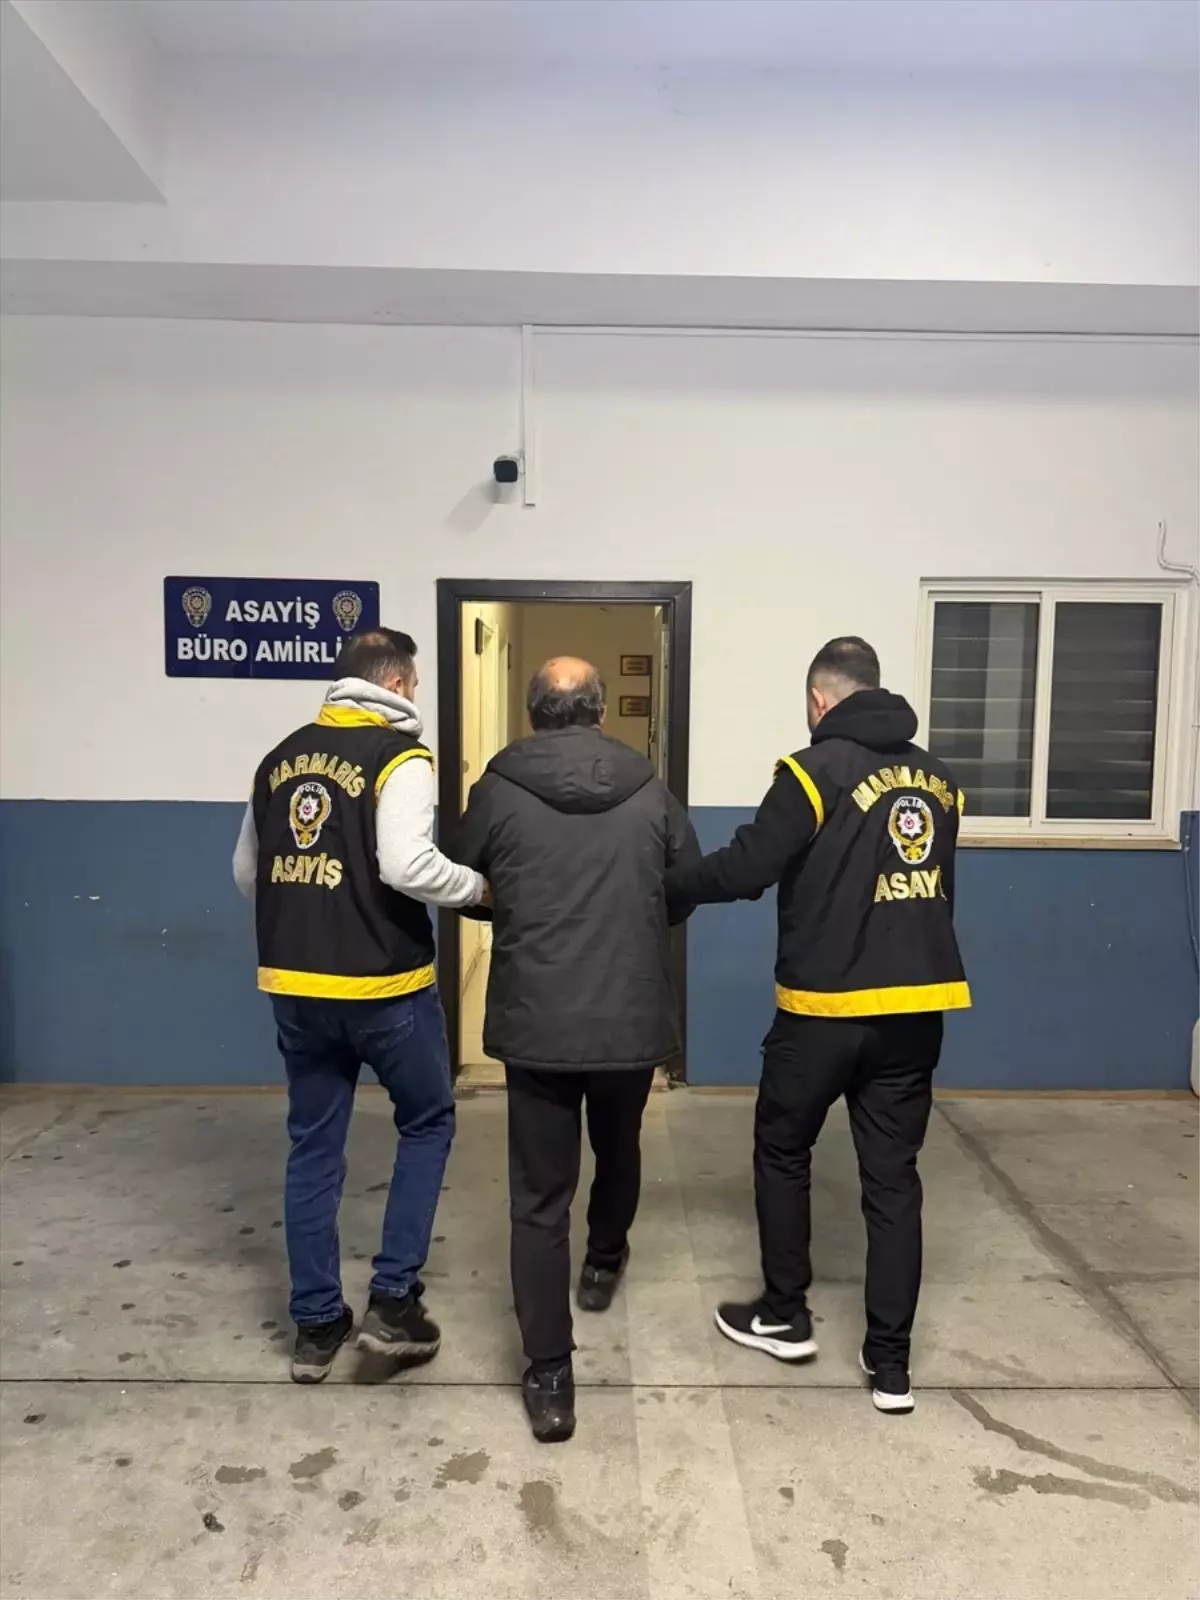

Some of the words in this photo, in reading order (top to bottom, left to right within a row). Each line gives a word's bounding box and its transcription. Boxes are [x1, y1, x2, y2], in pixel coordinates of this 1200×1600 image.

[225, 596, 321, 630] ASAYİŞ
[177, 633, 248, 662] BÜRO
[255, 635, 345, 664] AMİRLİ
[271, 852, 343, 890] ASAYİŞ
[874, 865, 948, 903] ASAY
